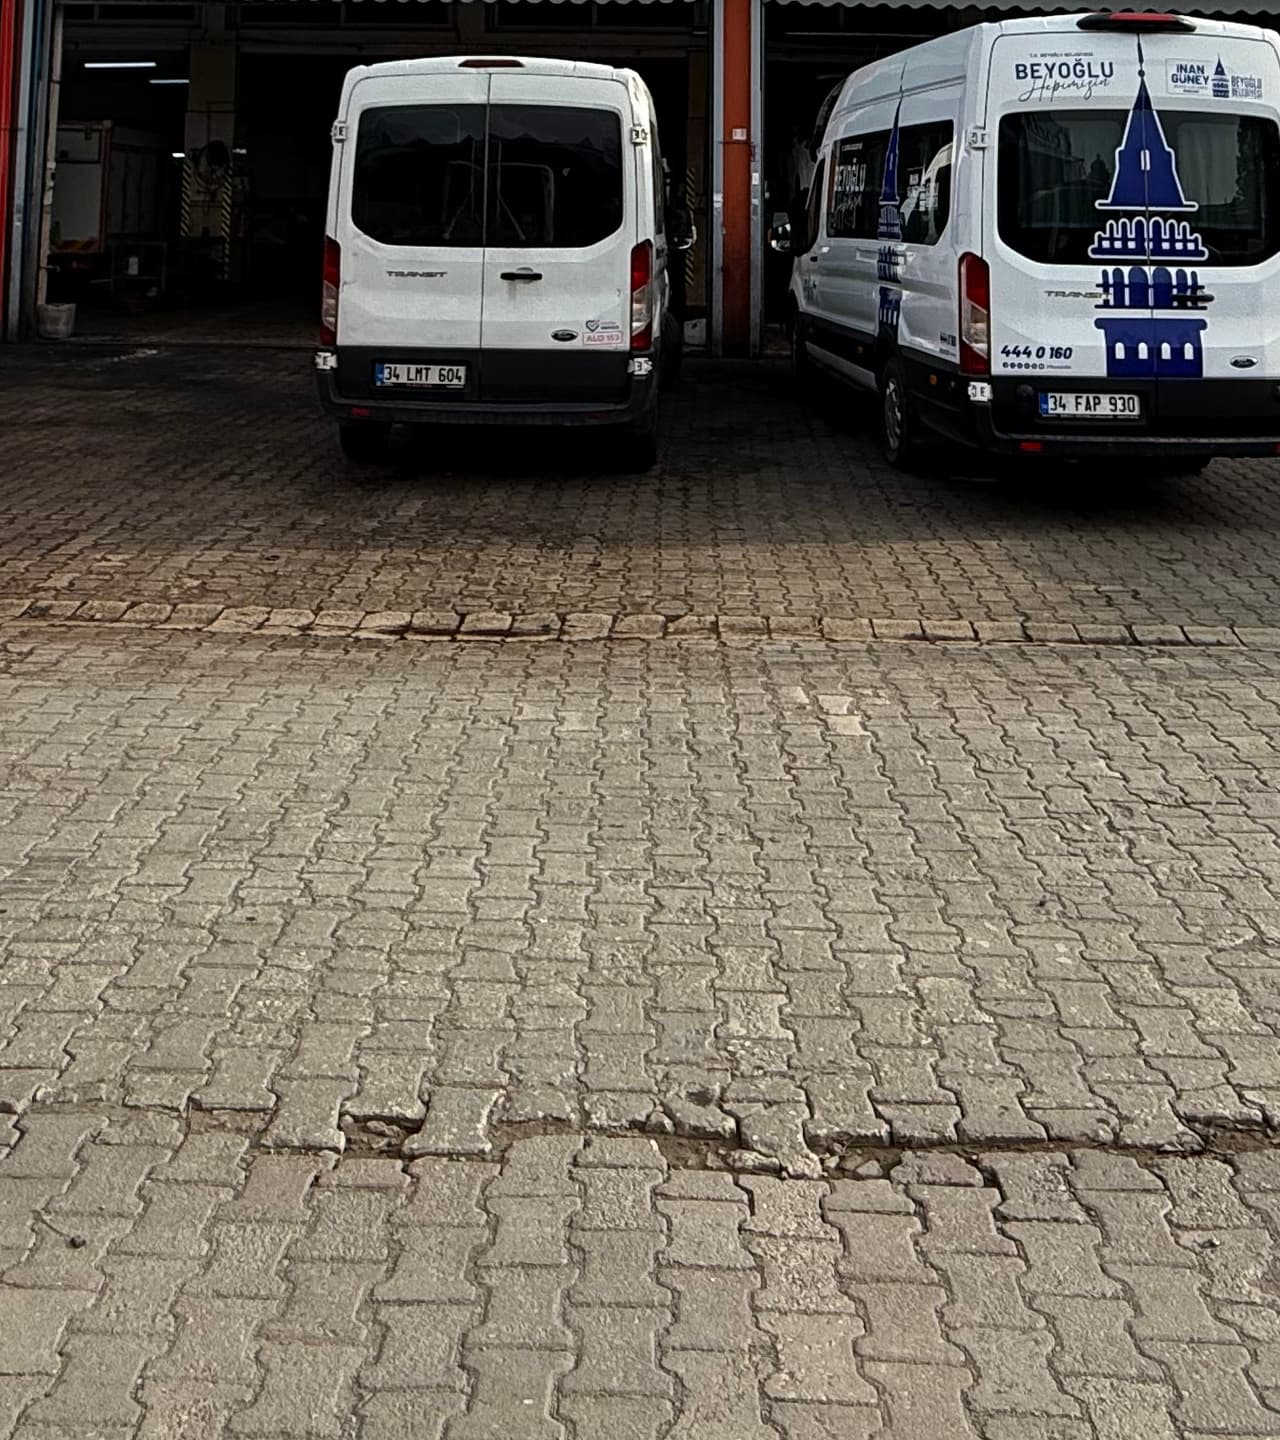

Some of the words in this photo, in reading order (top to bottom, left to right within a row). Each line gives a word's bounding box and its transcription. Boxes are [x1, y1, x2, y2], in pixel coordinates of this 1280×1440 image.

[1015, 58, 1114, 80] BEYOĞLU
[1001, 345, 1031, 358] 444
[1036, 346, 1046, 359] 0
[1049, 346, 1073, 360] 160
[385, 366, 400, 380] 34
[406, 367, 431, 382] LMT
[438, 368, 462, 382] 604
[1050, 395, 1066, 411] 34
[1075, 396, 1101, 412] FAP
[1109, 396, 1135, 413] 930
